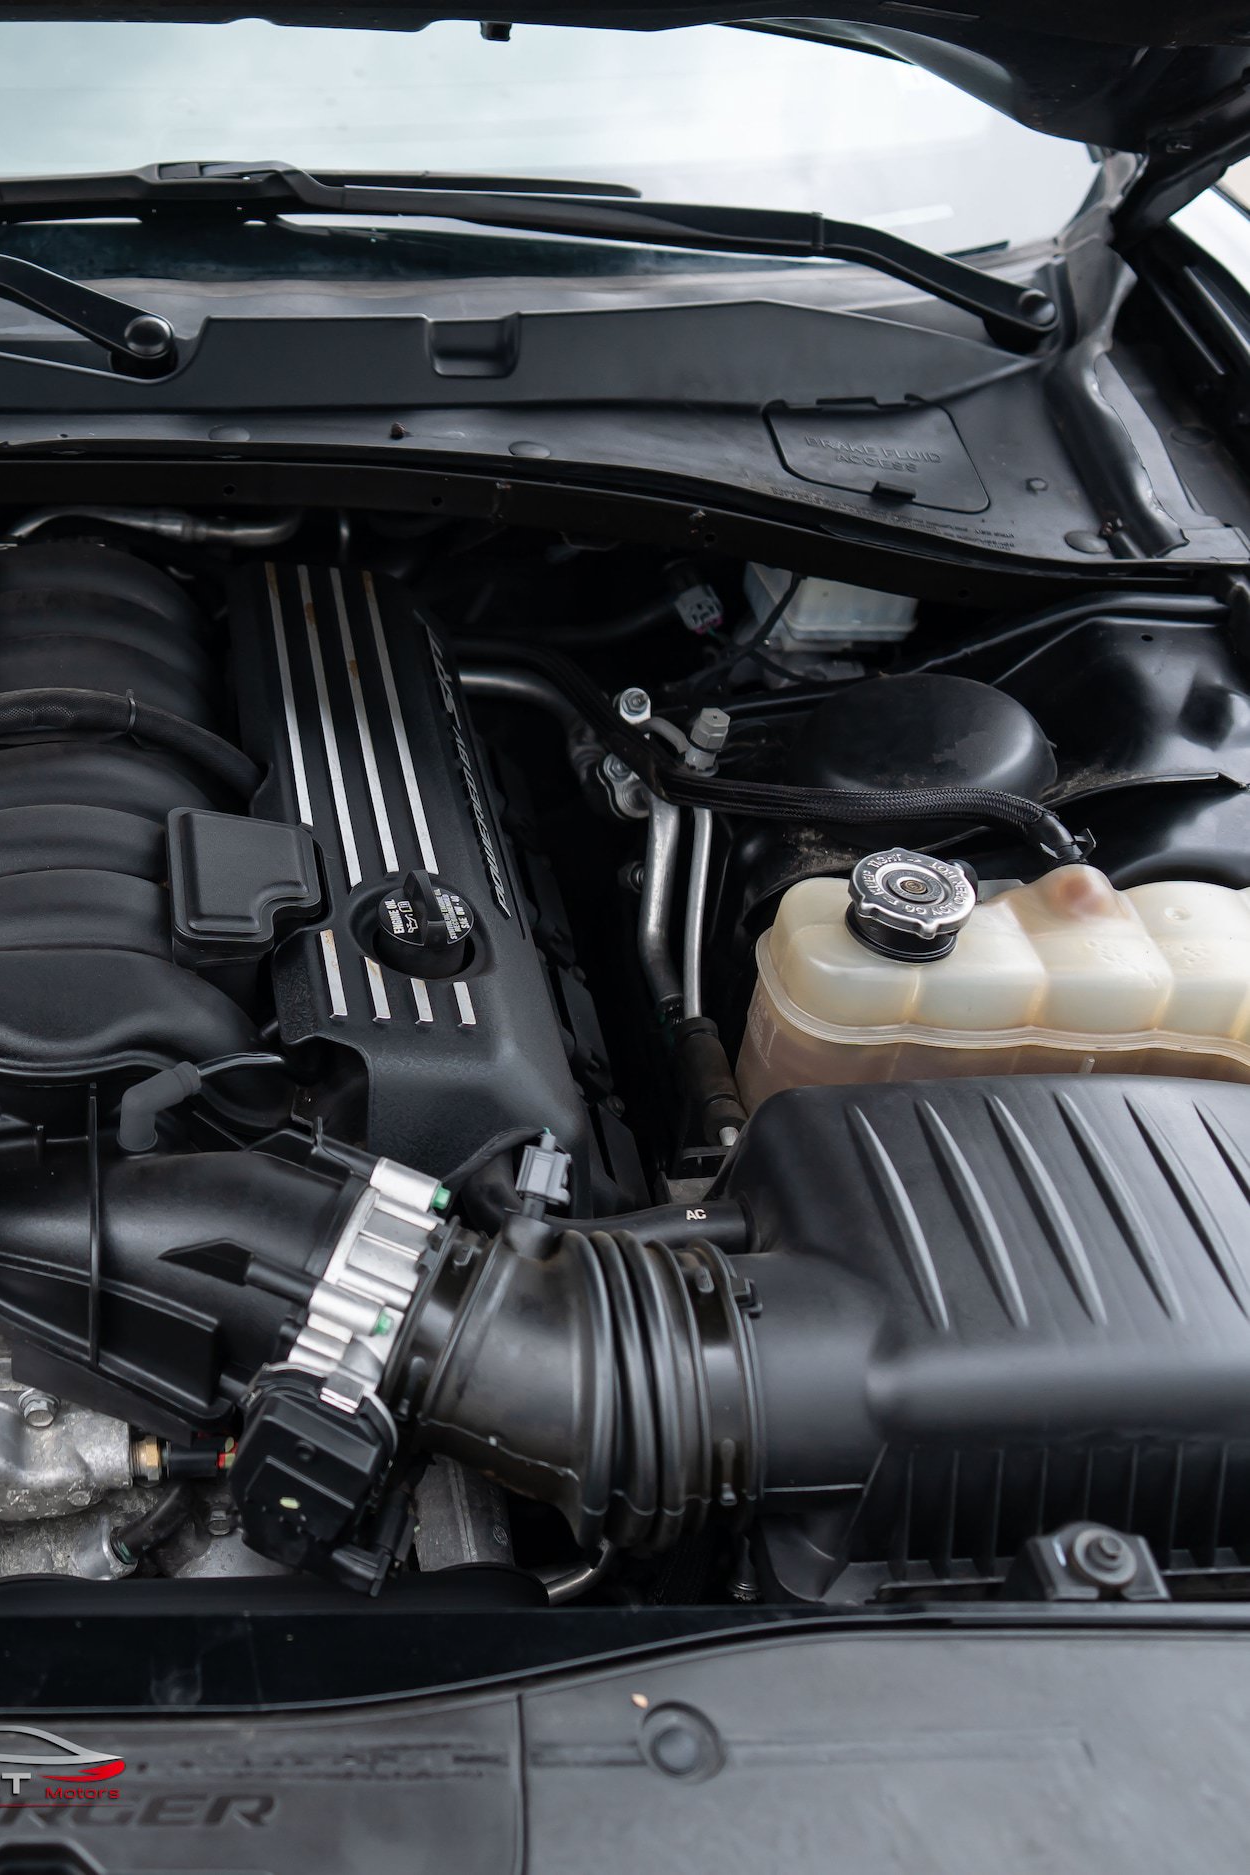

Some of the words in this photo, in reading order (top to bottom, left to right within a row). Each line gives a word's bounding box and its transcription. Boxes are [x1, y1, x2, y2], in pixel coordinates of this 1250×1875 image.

[804, 435, 873, 456] BRAKE
[881, 445, 942, 464] FLUID
[837, 454, 918, 473] ACCESS
[452, 724, 471, 770] BY
[461, 766, 512, 918] POWERED
[867, 853, 902, 868] TIGHT
[930, 862, 957, 879] HOT
[863, 869, 884, 896] KEEP
[953, 879, 968, 905] OPEN
[384, 899, 397, 910] OIL
[932, 902, 959, 916] NOT
[388, 909, 405, 934] ENGINE
[457, 917, 470, 929] SAE
[686, 1208, 707, 1220] AC
